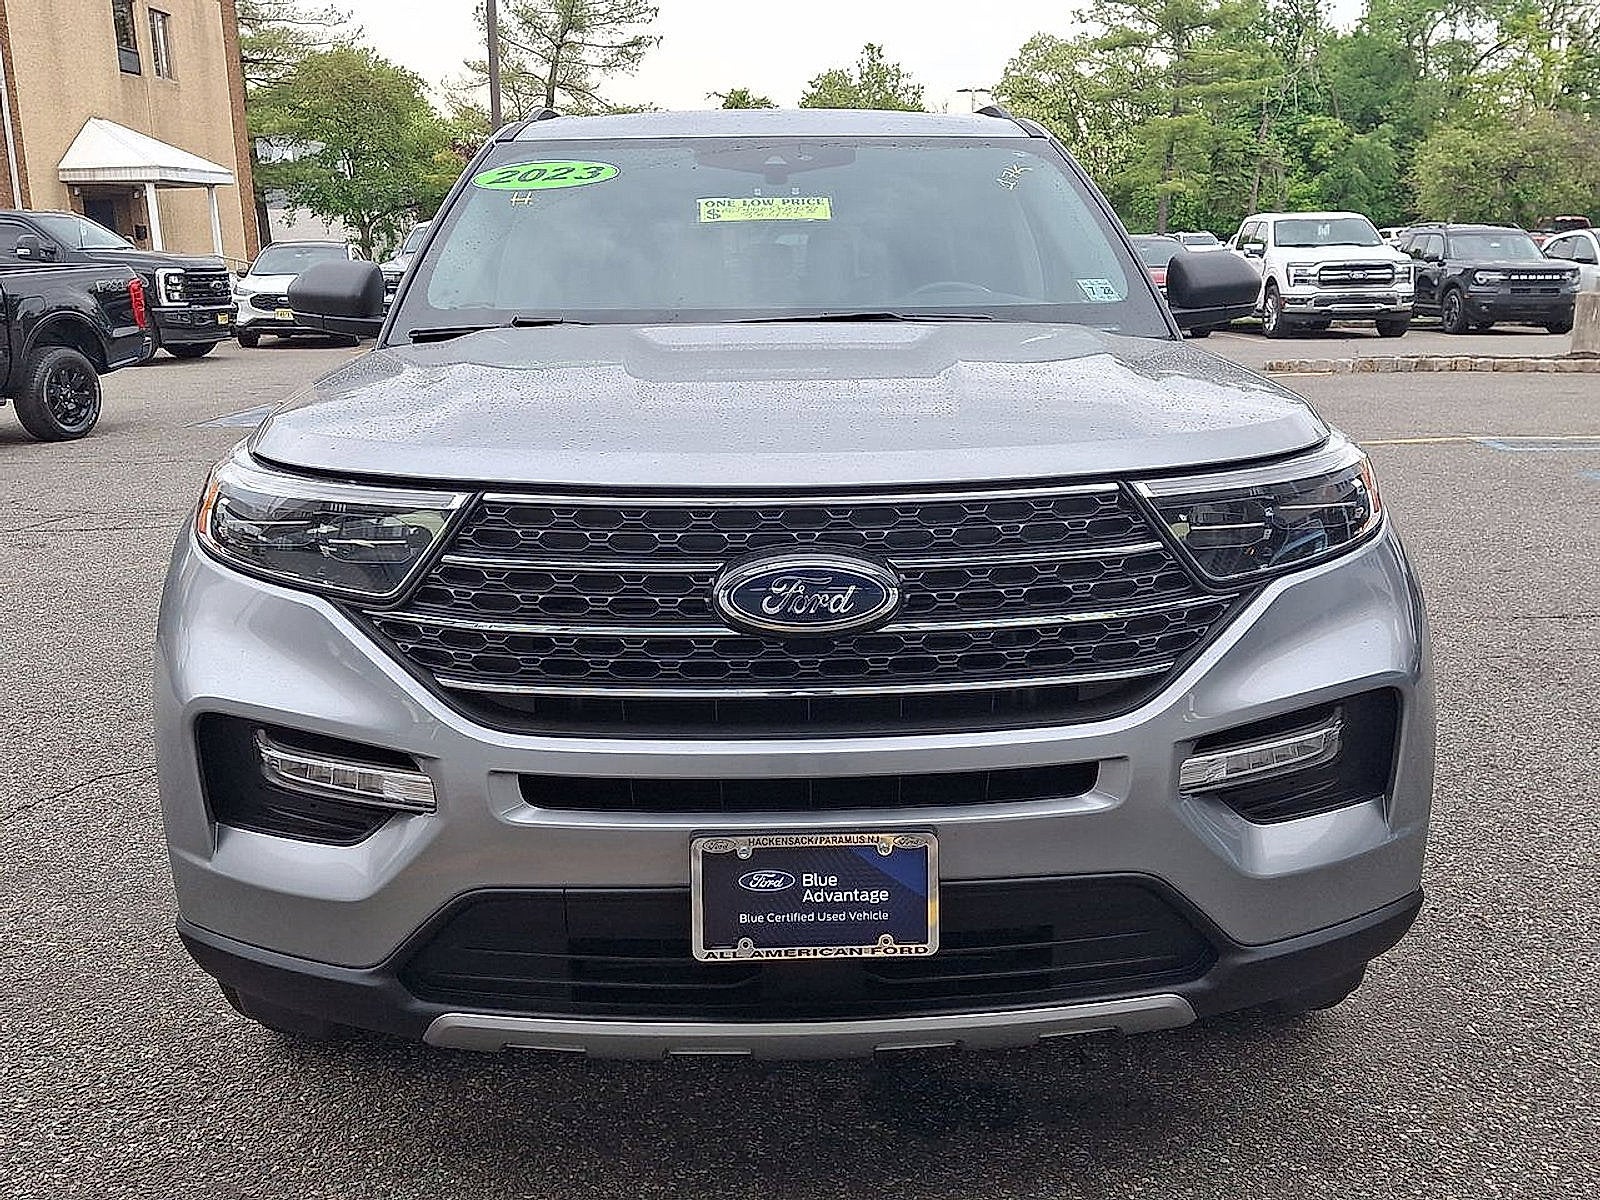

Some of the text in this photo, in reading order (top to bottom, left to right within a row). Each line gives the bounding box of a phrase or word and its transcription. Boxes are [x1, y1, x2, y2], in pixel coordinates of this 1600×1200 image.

[486, 166, 605, 185] 2023
[762, 575, 856, 615] Ford
[749, 873, 785, 888] Ford
[802, 872, 838, 887] Blue
[802, 887, 889, 904] Advantage
[739, 910, 889, 924] Blue Certified Used Vehicle
[703, 945, 929, 960] ALL AMERICAN FORD
